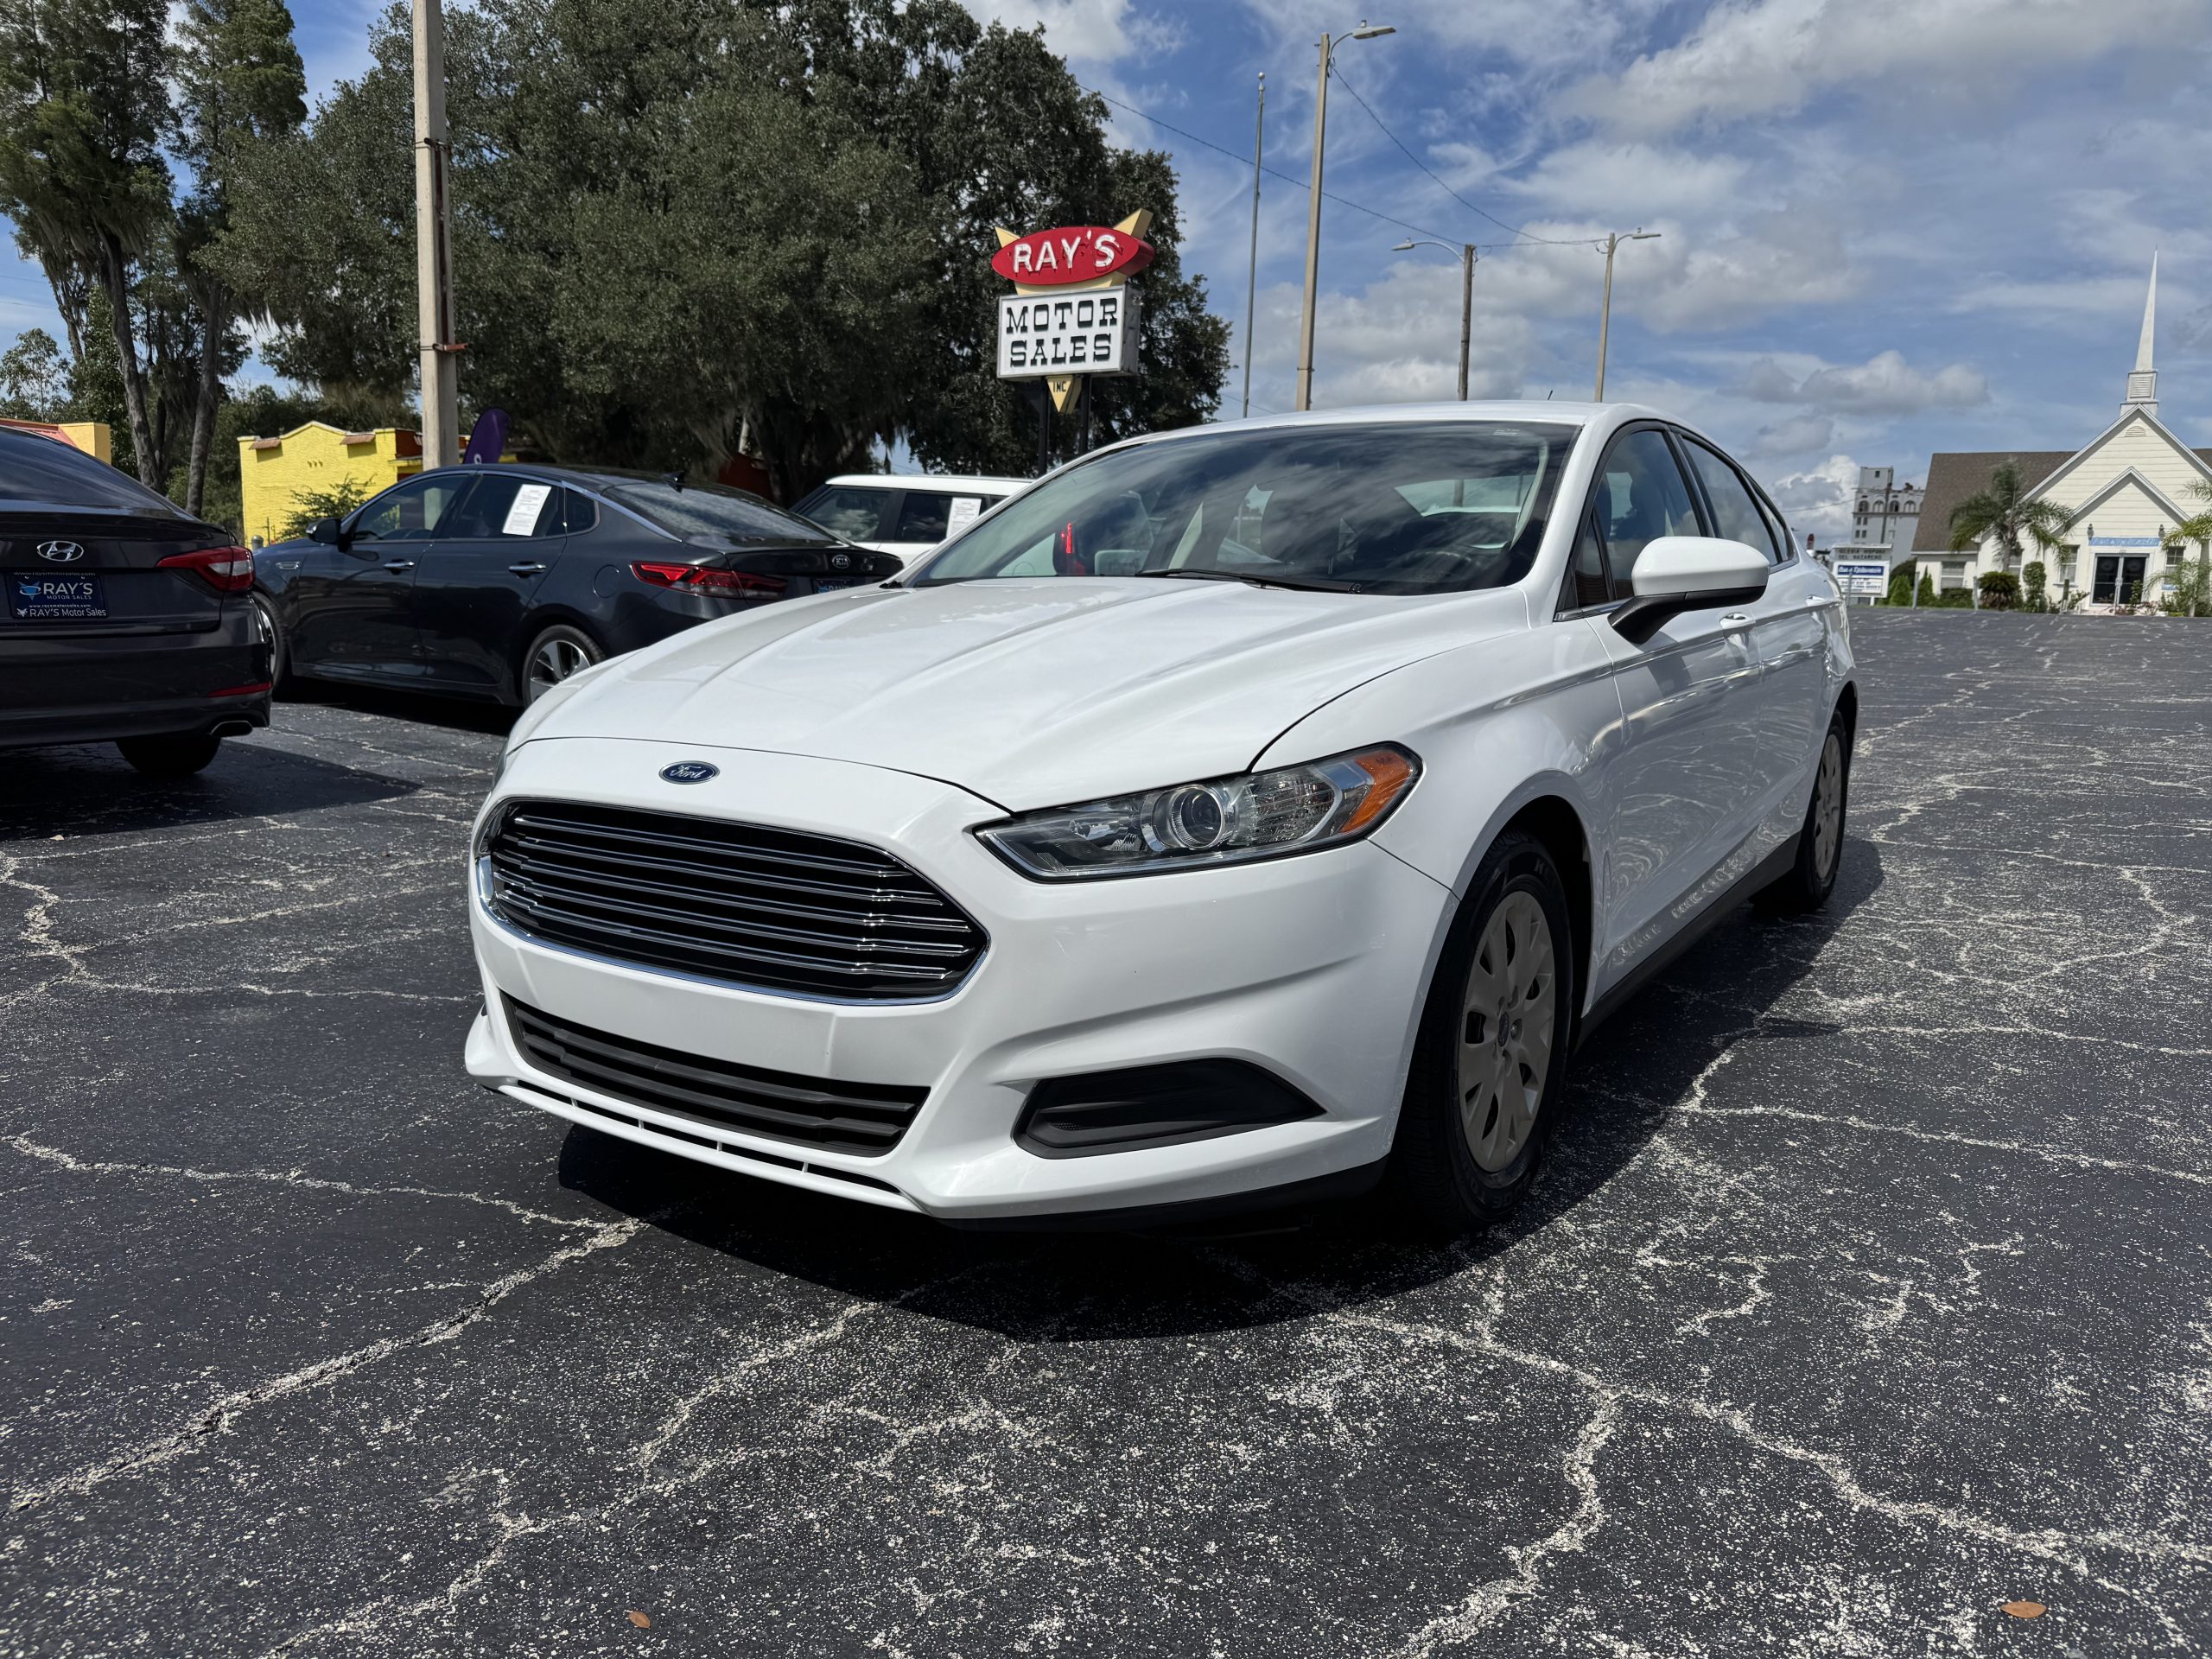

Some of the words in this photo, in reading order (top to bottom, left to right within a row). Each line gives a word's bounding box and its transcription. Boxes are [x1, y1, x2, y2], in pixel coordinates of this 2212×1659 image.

[1013, 229, 1121, 273] RAY'S
[1006, 297, 1117, 334] MOTOR
[1010, 333, 1111, 367] SALES
[1052, 381, 1067, 393] INC
[836, 557, 849, 566] KIA
[43, 582, 93, 595] RAY'S
[29, 608, 60, 617] RAY'S
[61, 608, 85, 617] Motor
[86, 607, 107, 617] Sales
[669, 765, 707, 779] Ford
